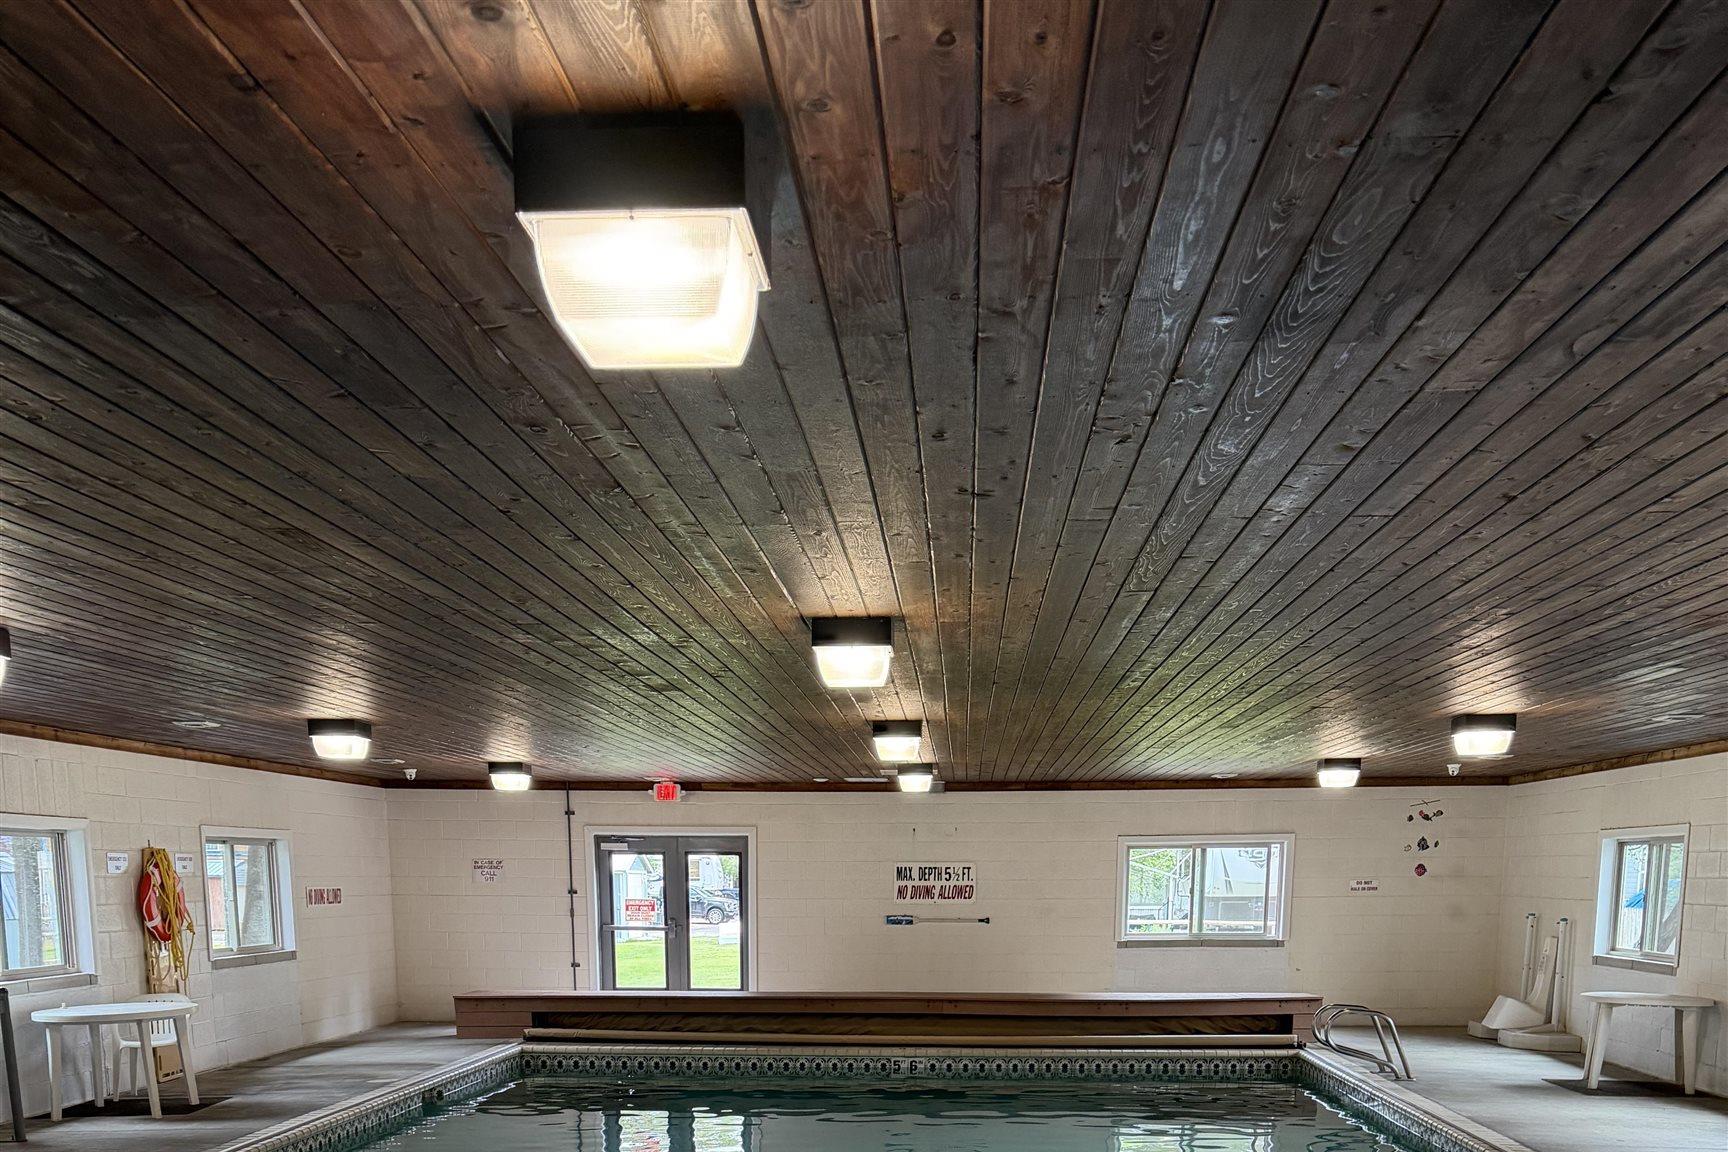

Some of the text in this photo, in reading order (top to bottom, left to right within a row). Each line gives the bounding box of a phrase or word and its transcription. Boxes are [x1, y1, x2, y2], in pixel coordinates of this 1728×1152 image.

[657, 784, 677, 800] EXIT
[896, 866, 916, 882] MAX.
[918, 866, 943, 882] DEPTH
[961, 866, 974, 882] FT.
[896, 885, 974, 900] NO DIVING ALLOWED
